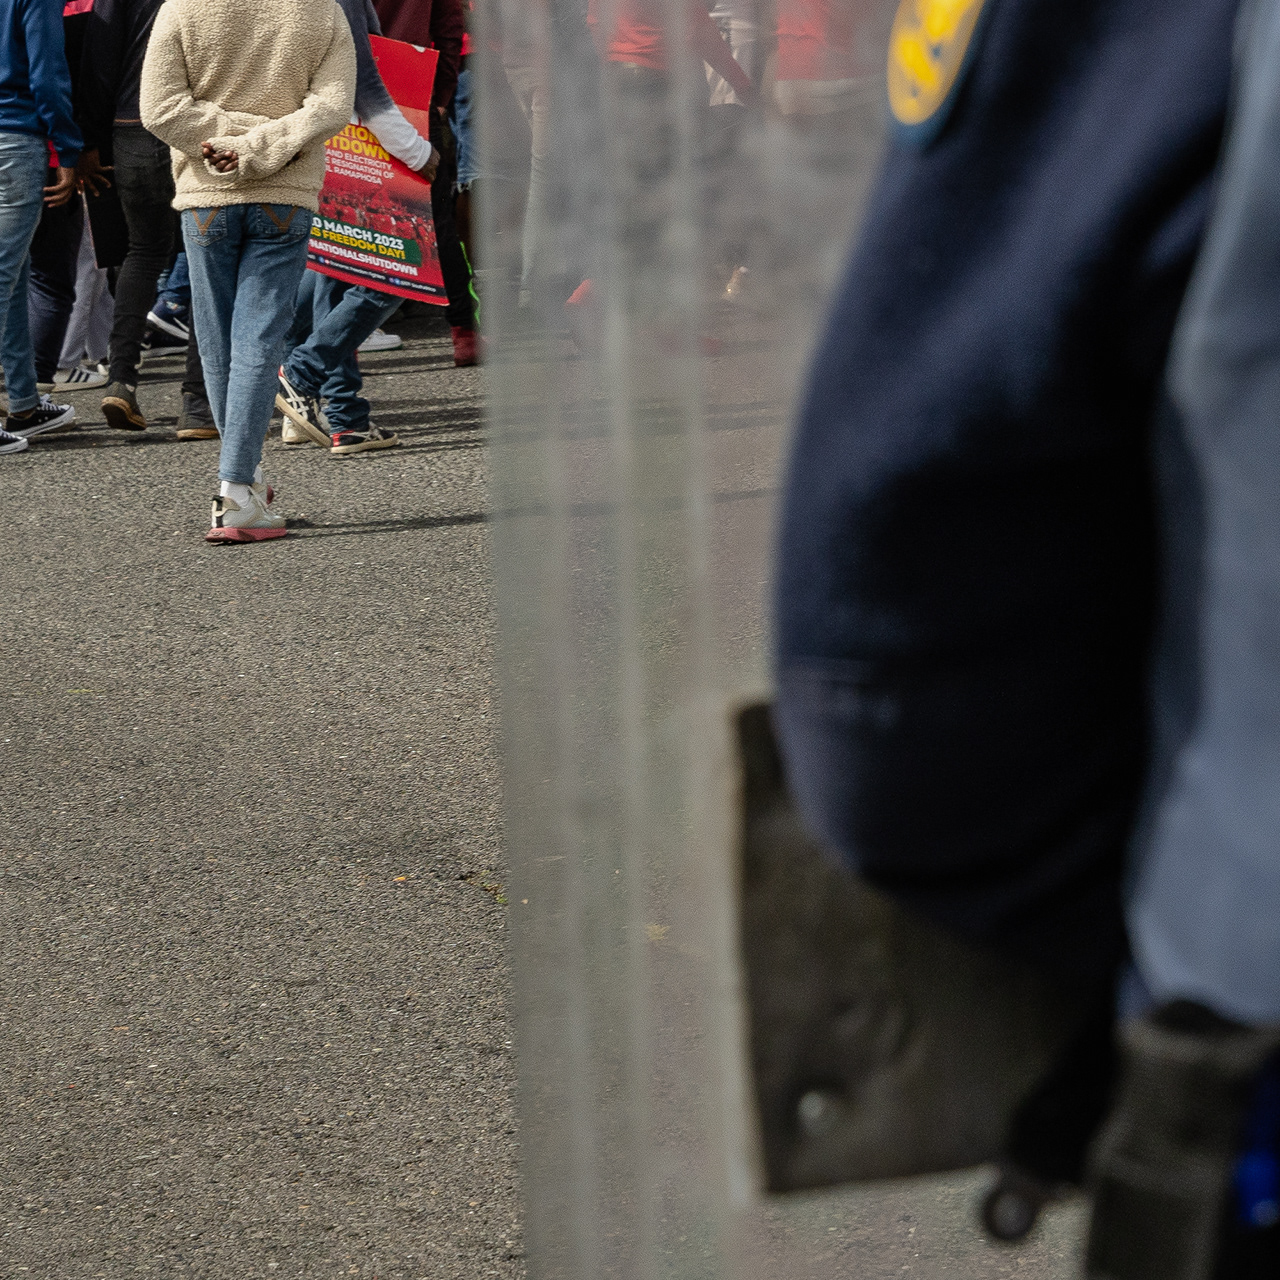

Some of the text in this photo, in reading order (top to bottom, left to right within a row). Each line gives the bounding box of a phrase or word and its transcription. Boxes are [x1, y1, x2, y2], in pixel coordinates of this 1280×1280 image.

[331, 157, 382, 177] RESIGNATION
[383, 171, 395, 180] OF
[344, 153, 392, 170] ELECTRICITY
[333, 166, 382, 185] RAMAPHOSA
[322, 230, 377, 252] FREEDOM
[378, 245, 406, 260] DAY!
[324, 220, 373, 242] MARCH
[373, 233, 404, 250] 2023
